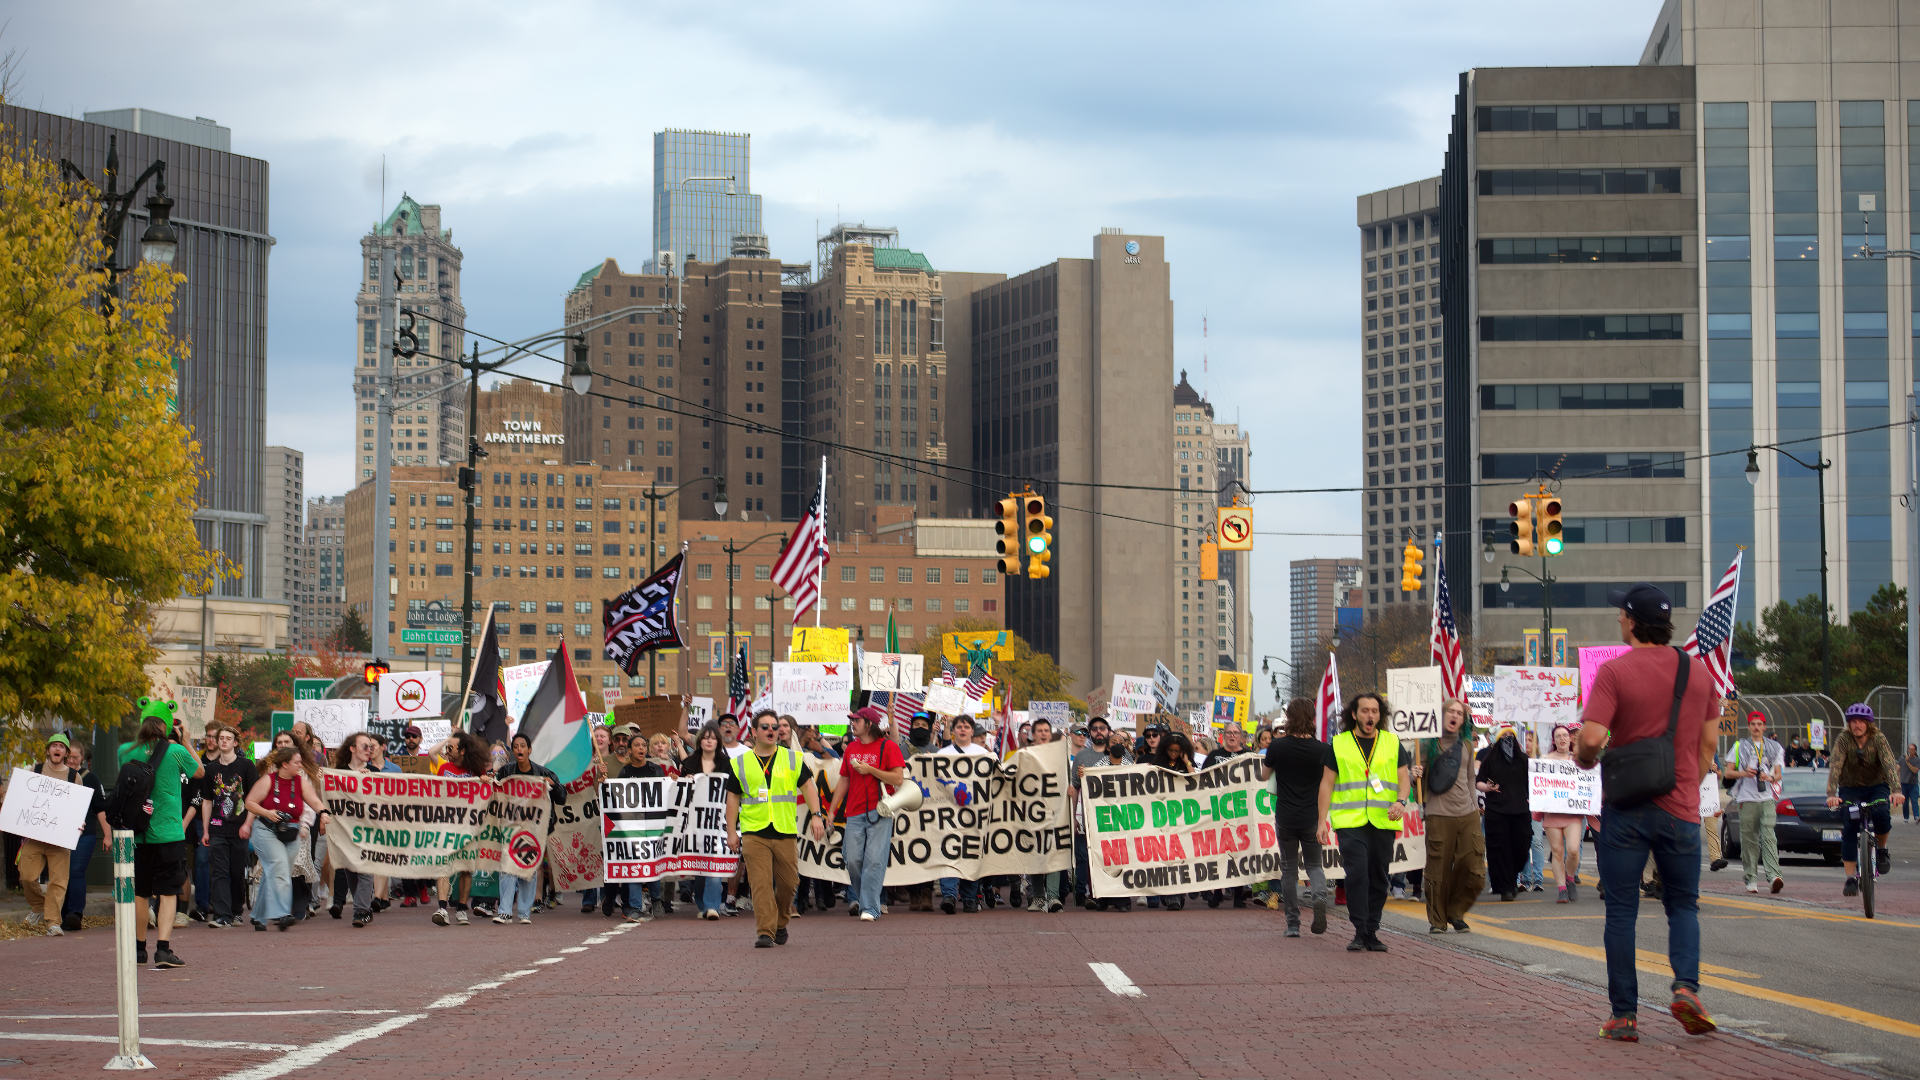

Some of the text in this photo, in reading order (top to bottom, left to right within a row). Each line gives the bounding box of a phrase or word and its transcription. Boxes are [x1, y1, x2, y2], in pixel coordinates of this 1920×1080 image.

[503, 420, 542, 432] TOWN
[485, 432, 565, 445] APARTMENTS
[408, 611, 425, 621] John
[435, 611, 458, 624] Lodge
[404, 631, 460, 644] John C Lodge
[1515, 669, 1556, 688] The Only
[182, 687, 211, 699] MELT
[191, 699, 207, 708] ICE
[1544, 691, 1552, 701] I
[1392, 709, 1438, 733] GAZA
[368, 725, 394, 740] HILE
[27, 775, 71, 800] CHINGA
[324, 774, 359, 794] END
[362, 776, 444, 798] STUDENT
[1086, 758, 1266, 799] DETROIT SANCTU
[1533, 775, 1576, 791] CRIMINALS
[32, 795, 51, 811] LA
[601, 780, 663, 809] FROM
[1567, 798, 1591, 812] ONE!
[16, 808, 58, 830] MIGRA
[327, 799, 366, 819] WSU
[368, 803, 468, 824] SANCTUARY
[583, 799, 600, 820] OU
[695, 806, 723, 831] THE
[1095, 803, 1145, 833] END
[1151, 789, 1249, 829] DPD-ICE
[352, 826, 411, 848] STAND
[414, 831, 441, 849] UP!
[703, 834, 720, 855] BE
[1100, 838, 1130, 867] NI
[1134, 833, 1187, 864] UNA
[1190, 821, 1251, 858] MÁS
[361, 850, 409, 872] STUDENTS
[410, 854, 427, 866] FOR
[427, 855, 433, 866] A
[887, 837, 931, 868] NO
[1194, 860, 1220, 883] DE
